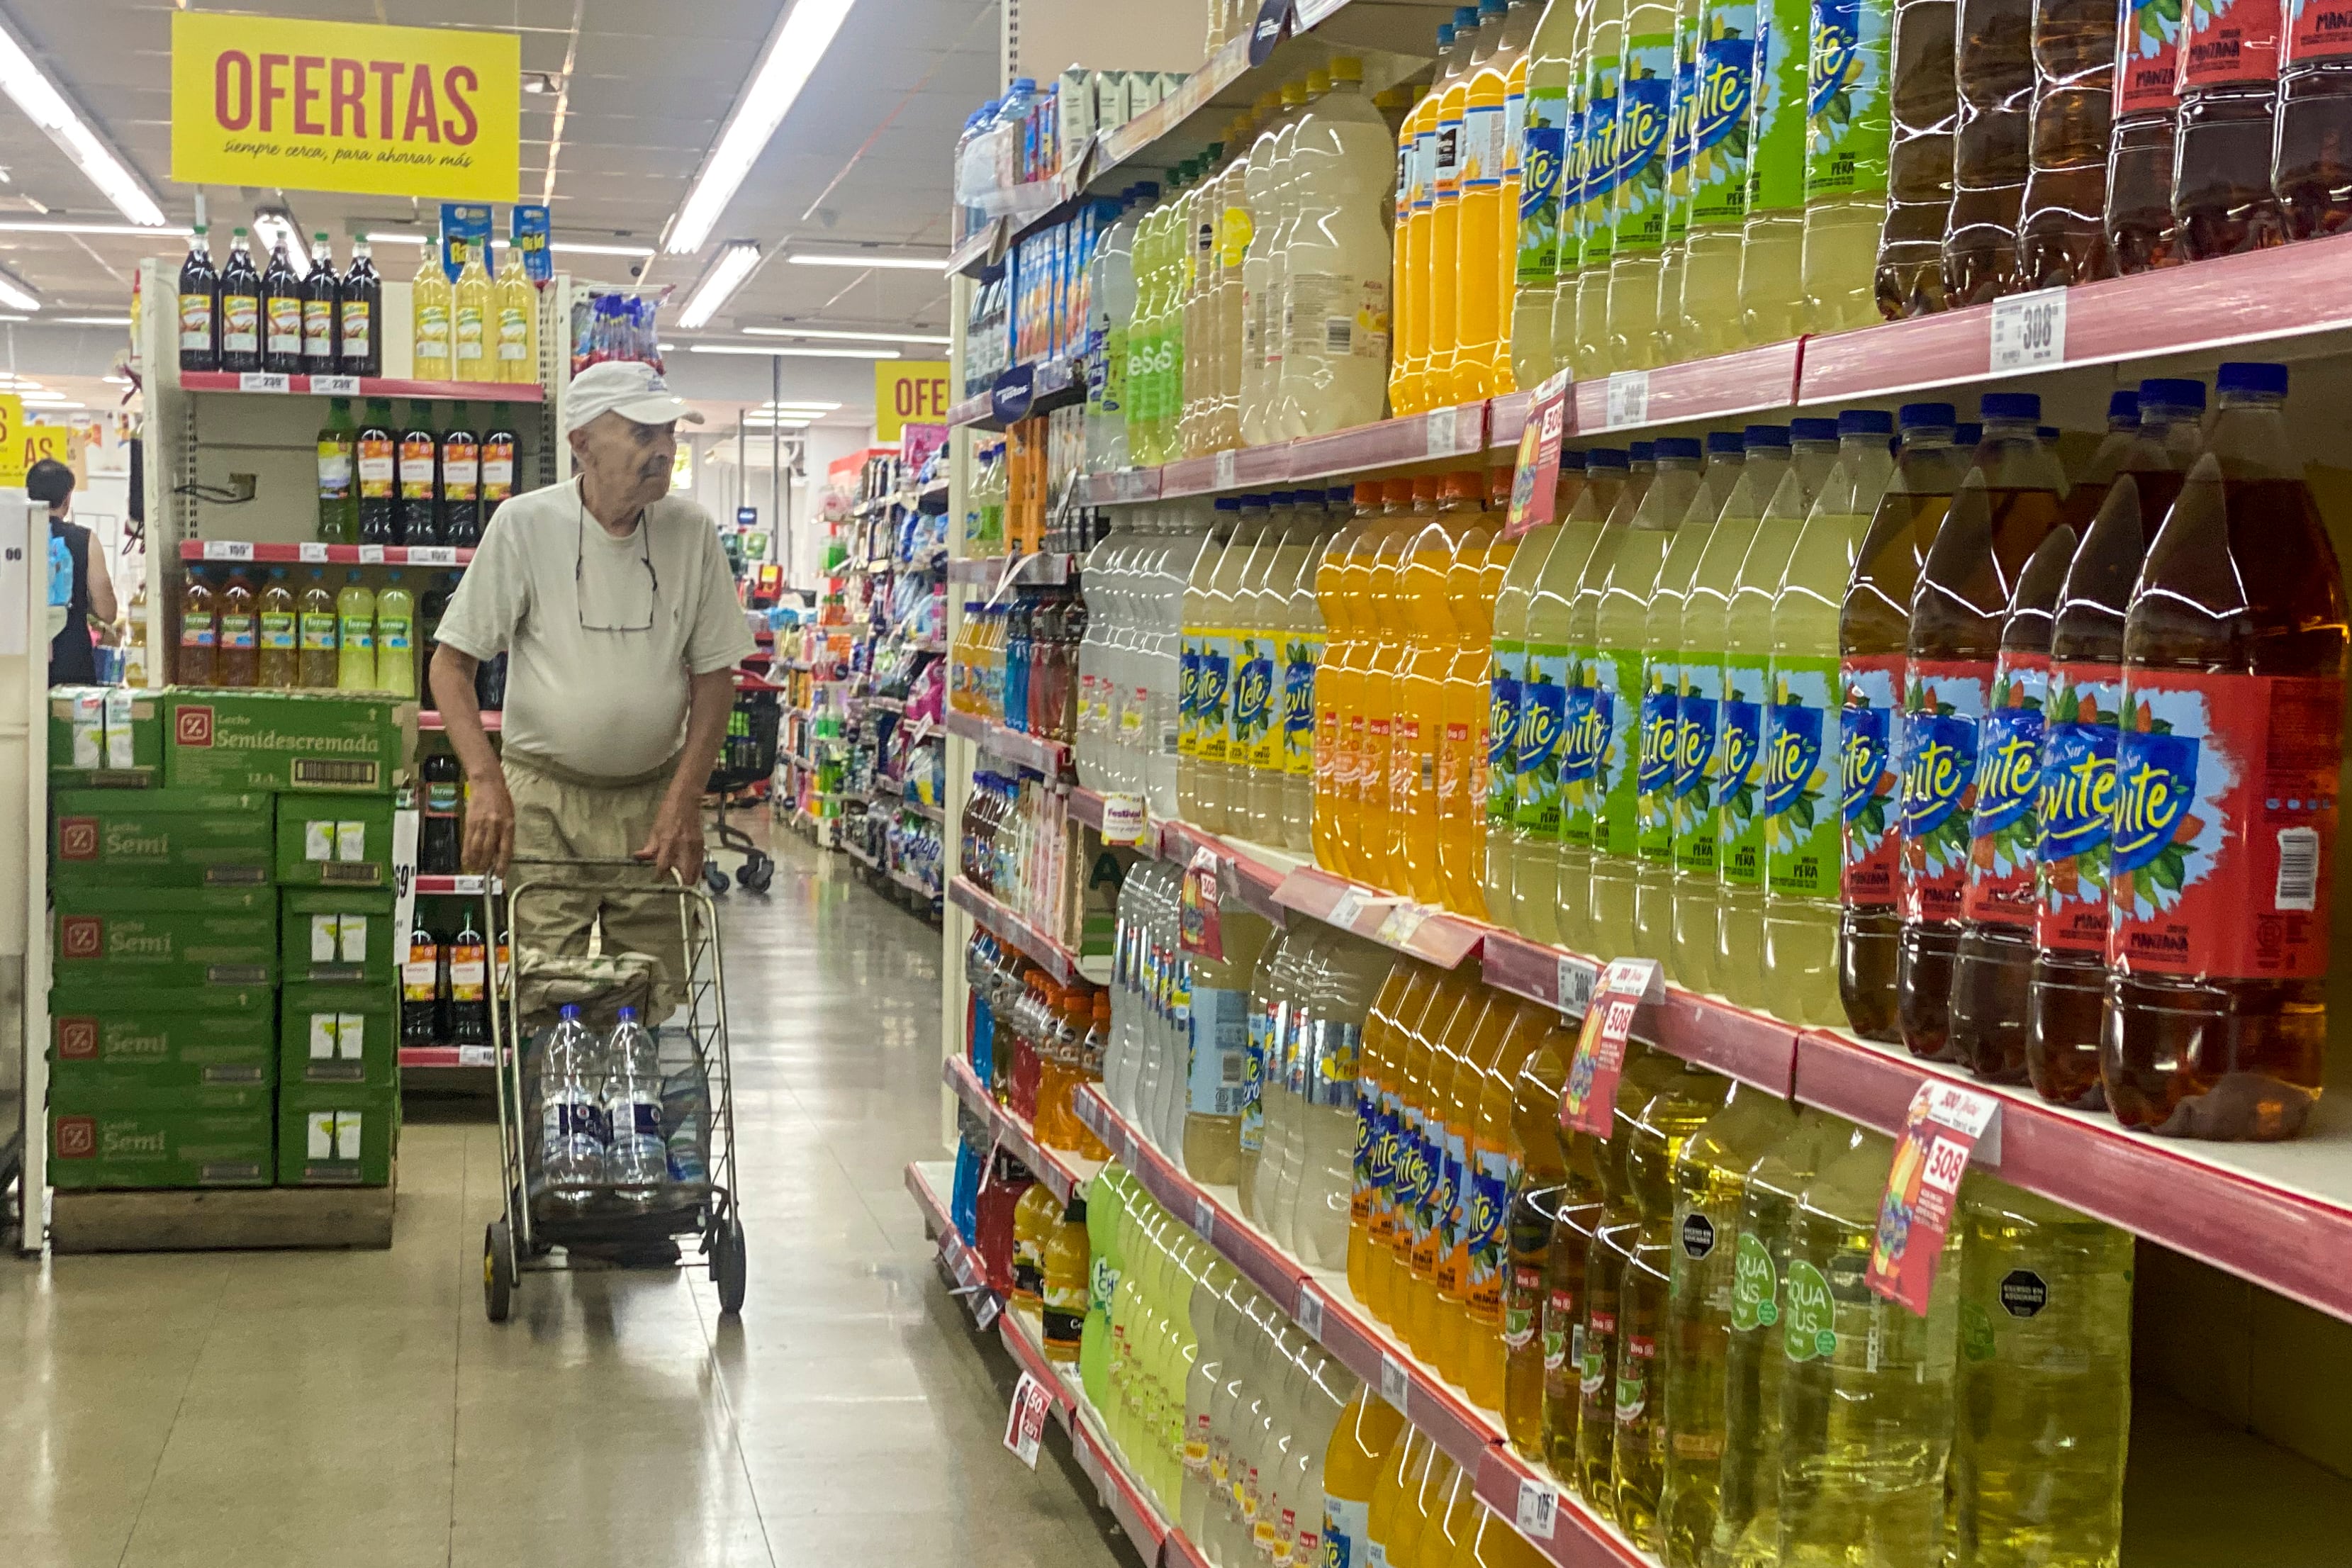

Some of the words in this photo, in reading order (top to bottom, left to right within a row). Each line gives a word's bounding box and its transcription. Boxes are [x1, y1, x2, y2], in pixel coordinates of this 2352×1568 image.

[215, 49, 478, 146] OFERTAS
[223, 139, 281, 159] siempre
[285, 144, 329, 163] cerca,
[332, 146, 372, 164] para
[377, 147, 437, 167] ahorrar
[439, 152, 474, 169] más
[895, 378, 951, 417] OFE
[1608, 1004, 1631, 1034] 308
[1930, 1143, 1964, 1184] 308
[1737, 1253, 1769, 1282] QUA
